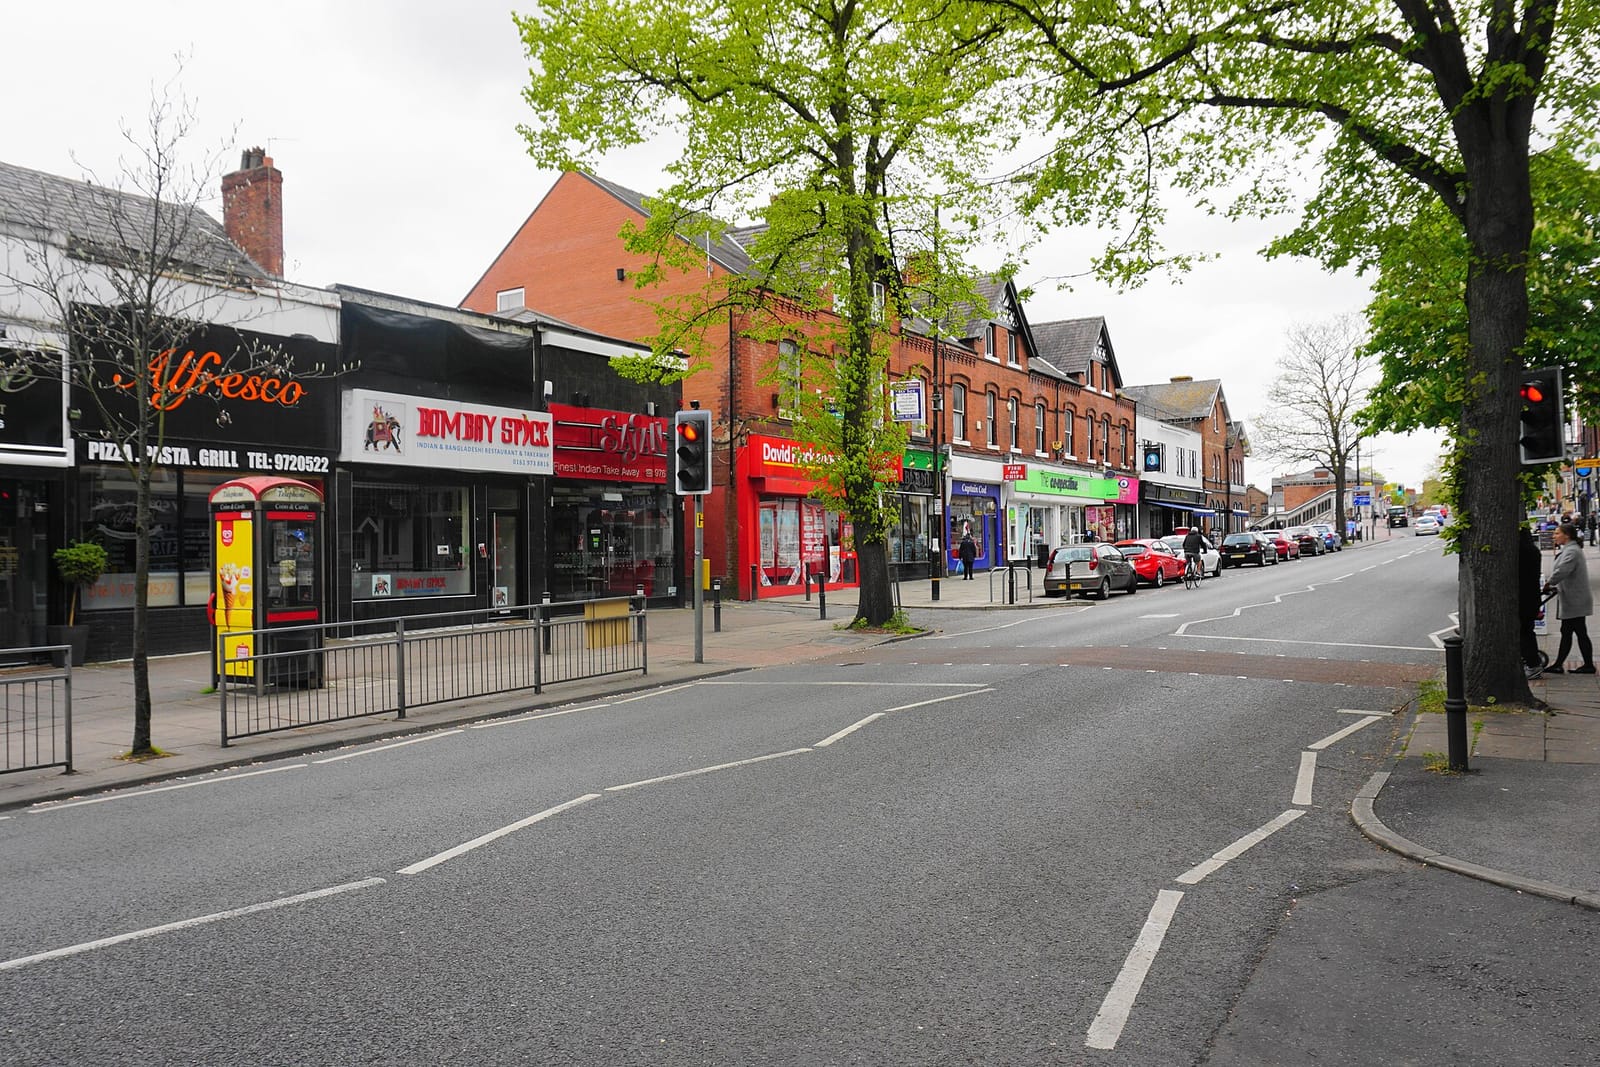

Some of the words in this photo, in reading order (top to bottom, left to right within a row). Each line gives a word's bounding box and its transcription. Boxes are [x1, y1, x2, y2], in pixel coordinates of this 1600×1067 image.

[113, 348, 309, 411] Alfresco
[416, 407, 497, 444] BOMBAY
[501, 414, 550, 448] SPICE
[416, 442, 438, 450] INDIAN
[445, 444, 485, 454] BANGLADESHI
[485, 447, 518, 456] RESTAURANT
[763, 443, 790, 463] David
[199, 449, 239, 468] GRILL
[247, 452, 273, 470] TEL:
[274, 453, 329, 473] 9720522
[554, 462, 577, 472] Finest
[578, 465, 602, 474] Indian
[602, 465, 620, 475] Take
[621, 467, 640, 477] Away
[961, 483, 979, 495] Captain
[978, 485, 988, 494] Cod
